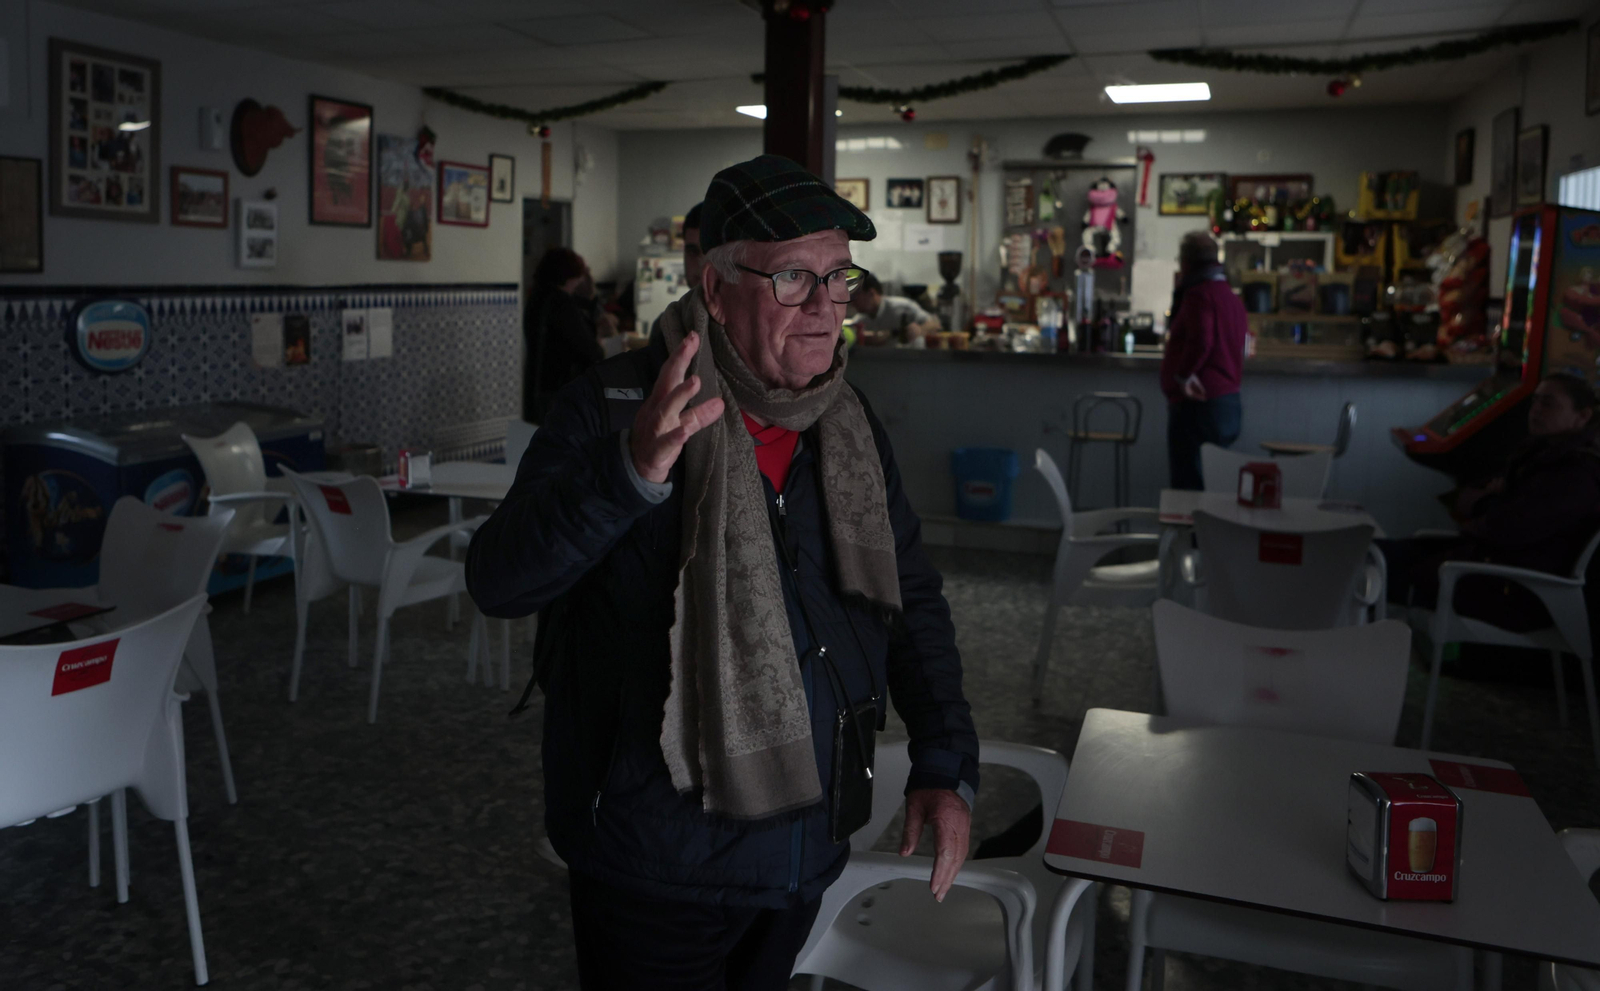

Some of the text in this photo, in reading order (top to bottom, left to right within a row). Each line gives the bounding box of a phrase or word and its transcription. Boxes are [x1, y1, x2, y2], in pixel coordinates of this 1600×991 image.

[61, 655, 108, 672] Cruzcampo
[1098, 829, 1117, 859] Cruzcampo
[1394, 871, 1447, 883] Cruzcampo
